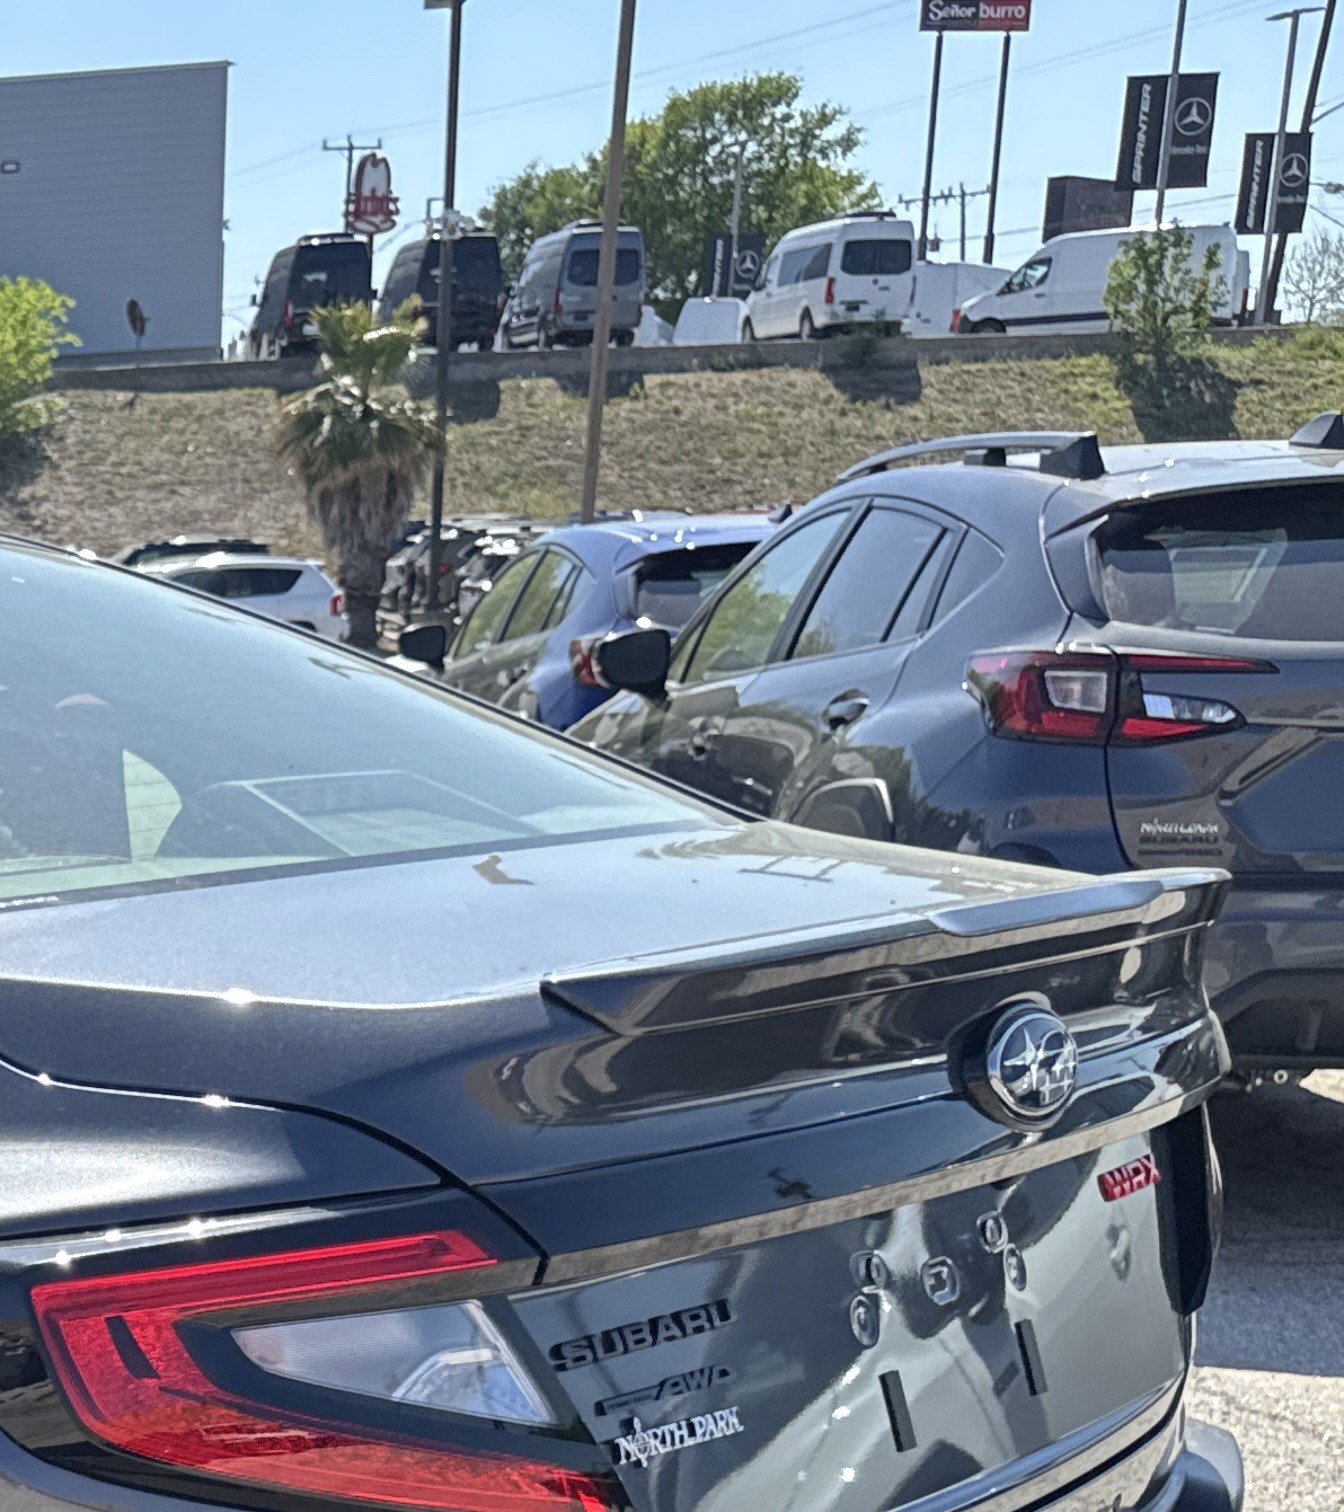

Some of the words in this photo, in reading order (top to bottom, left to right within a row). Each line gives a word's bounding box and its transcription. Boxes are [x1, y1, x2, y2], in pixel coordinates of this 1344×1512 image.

[979, 2, 1026, 18] burro
[1099, 1153, 1161, 1202] WRX
[614, 1417, 690, 1467] NORTH
[690, 1406, 745, 1443] PARK
